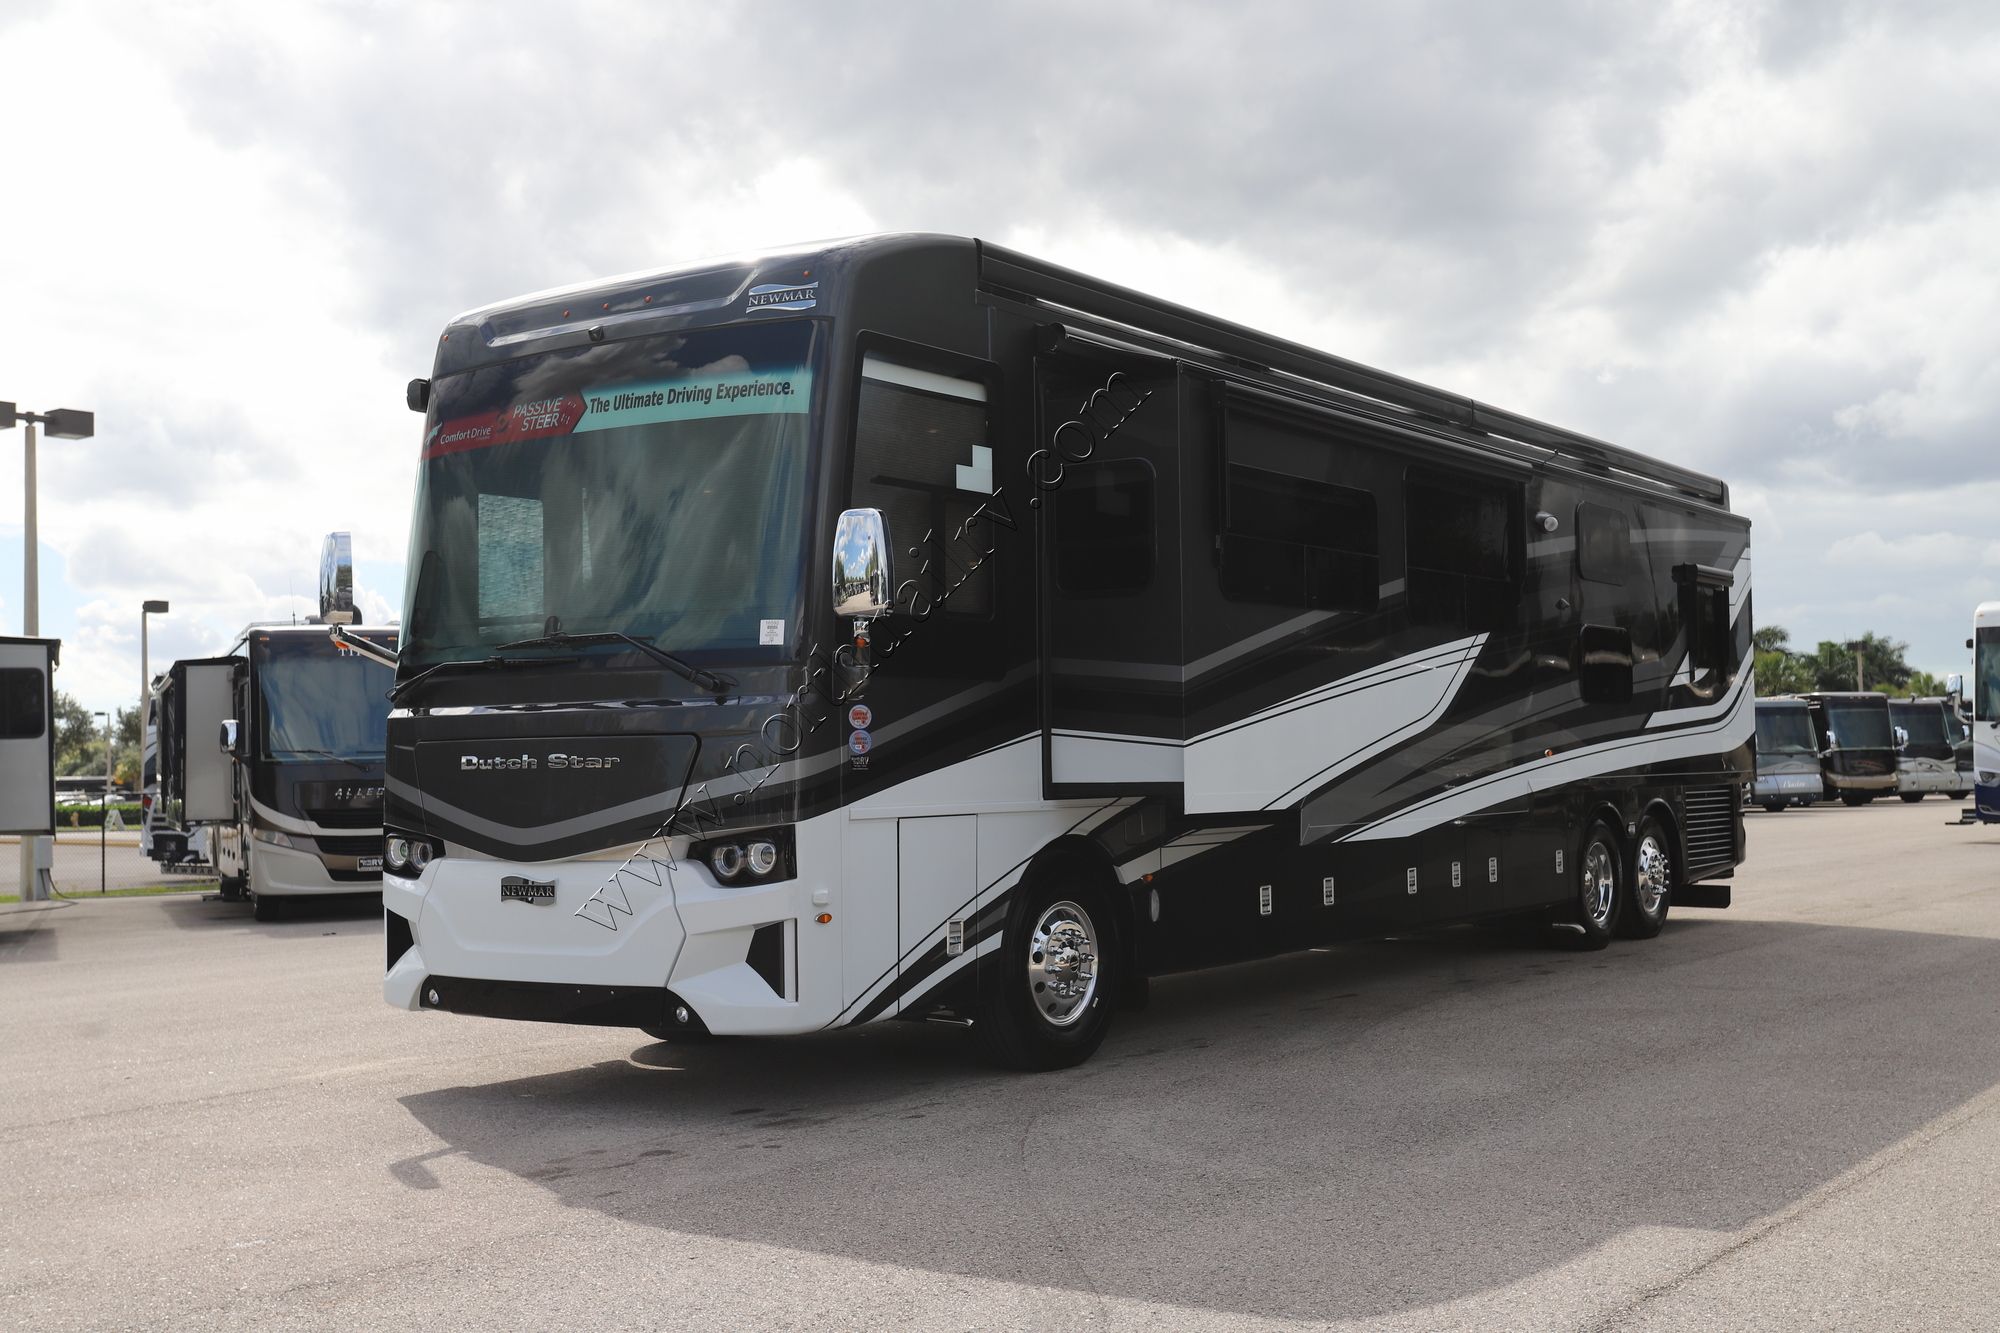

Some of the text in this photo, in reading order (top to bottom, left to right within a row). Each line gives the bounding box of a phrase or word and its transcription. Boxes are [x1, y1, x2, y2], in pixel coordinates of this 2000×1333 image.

[748, 289, 816, 306] NEWMAR
[589, 380, 795, 414] The Ultimate Driving Experience.
[513, 397, 564, 418] PASSIVE
[521, 413, 560, 432] STEER
[440, 430, 470, 445] Comfort
[471, 427, 492, 439] Drive
[460, 753, 620, 771] Dutch Star
[502, 885, 554, 897] NEWMAR
